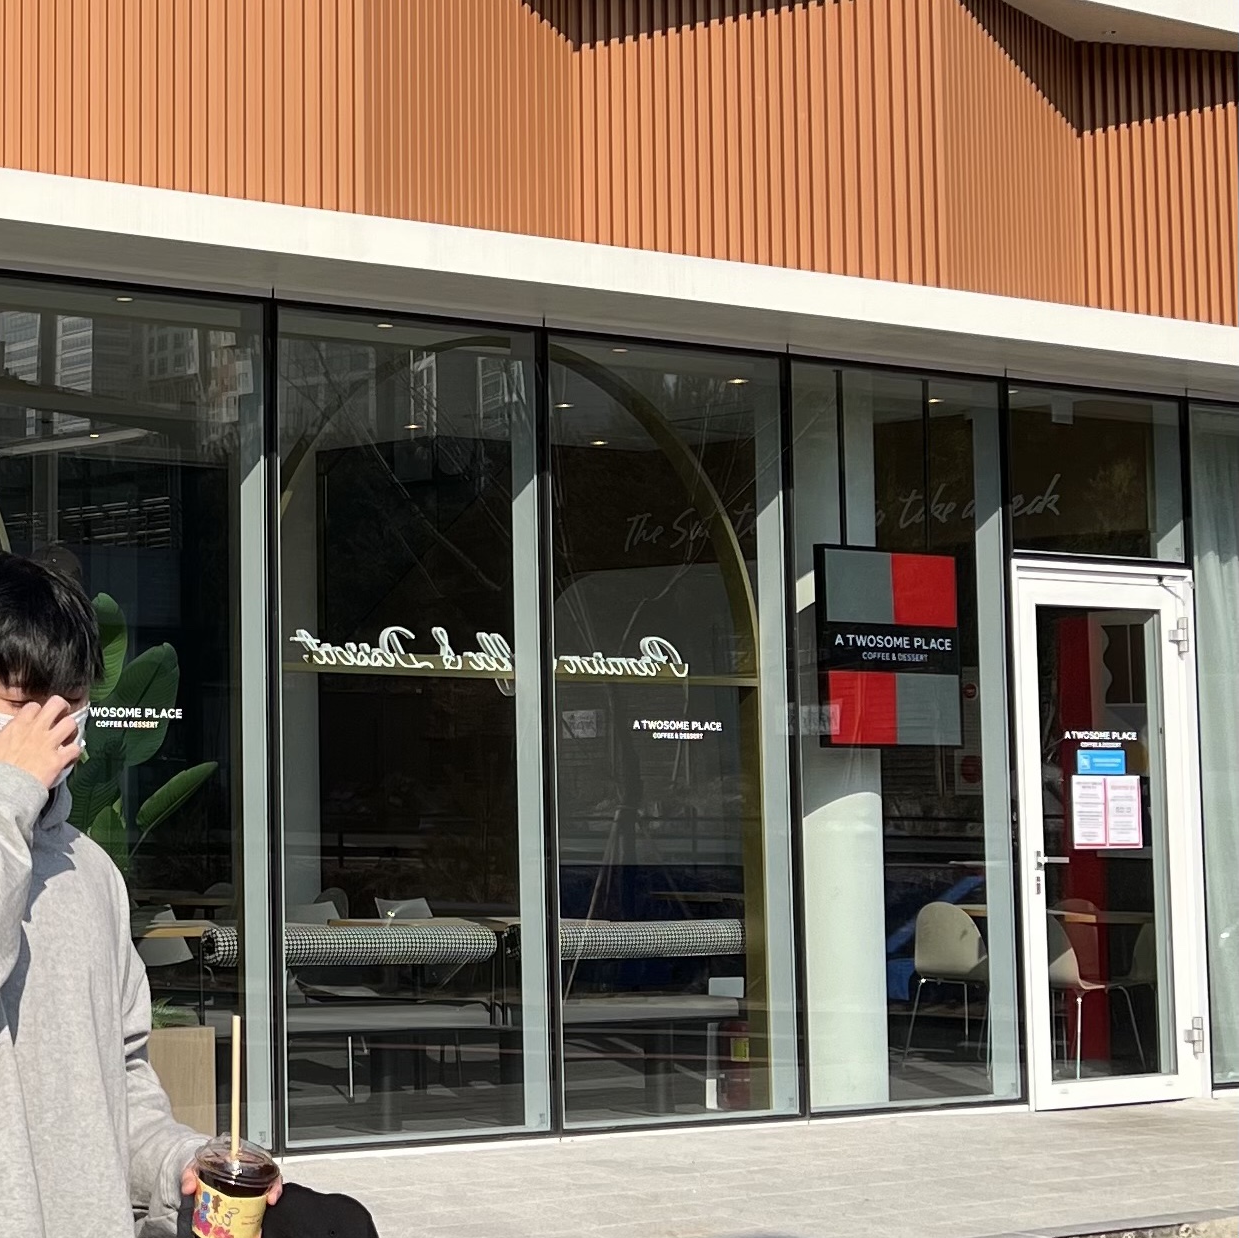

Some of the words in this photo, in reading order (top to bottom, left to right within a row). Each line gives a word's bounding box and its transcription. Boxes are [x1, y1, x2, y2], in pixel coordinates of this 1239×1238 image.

[835, 633, 845, 646] A
[846, 634, 911, 649] TWOSOME
[913, 637, 952, 651] PLACE
[862, 651, 891, 661] COFFEE
[897, 653, 929, 662] DESSERT
[89, 706, 142, 718] WOSOME
[144, 707, 183, 719] PLACE
[95, 719, 122, 728] COFFEE
[129, 720, 159, 729] DESSERT
[633, 719, 641, 730] A
[641, 719, 690, 731] TWOSOME
[690, 720, 723, 732] PLACE
[1064, 730, 1072, 740] A
[1111, 731, 1138, 741] PLACE
